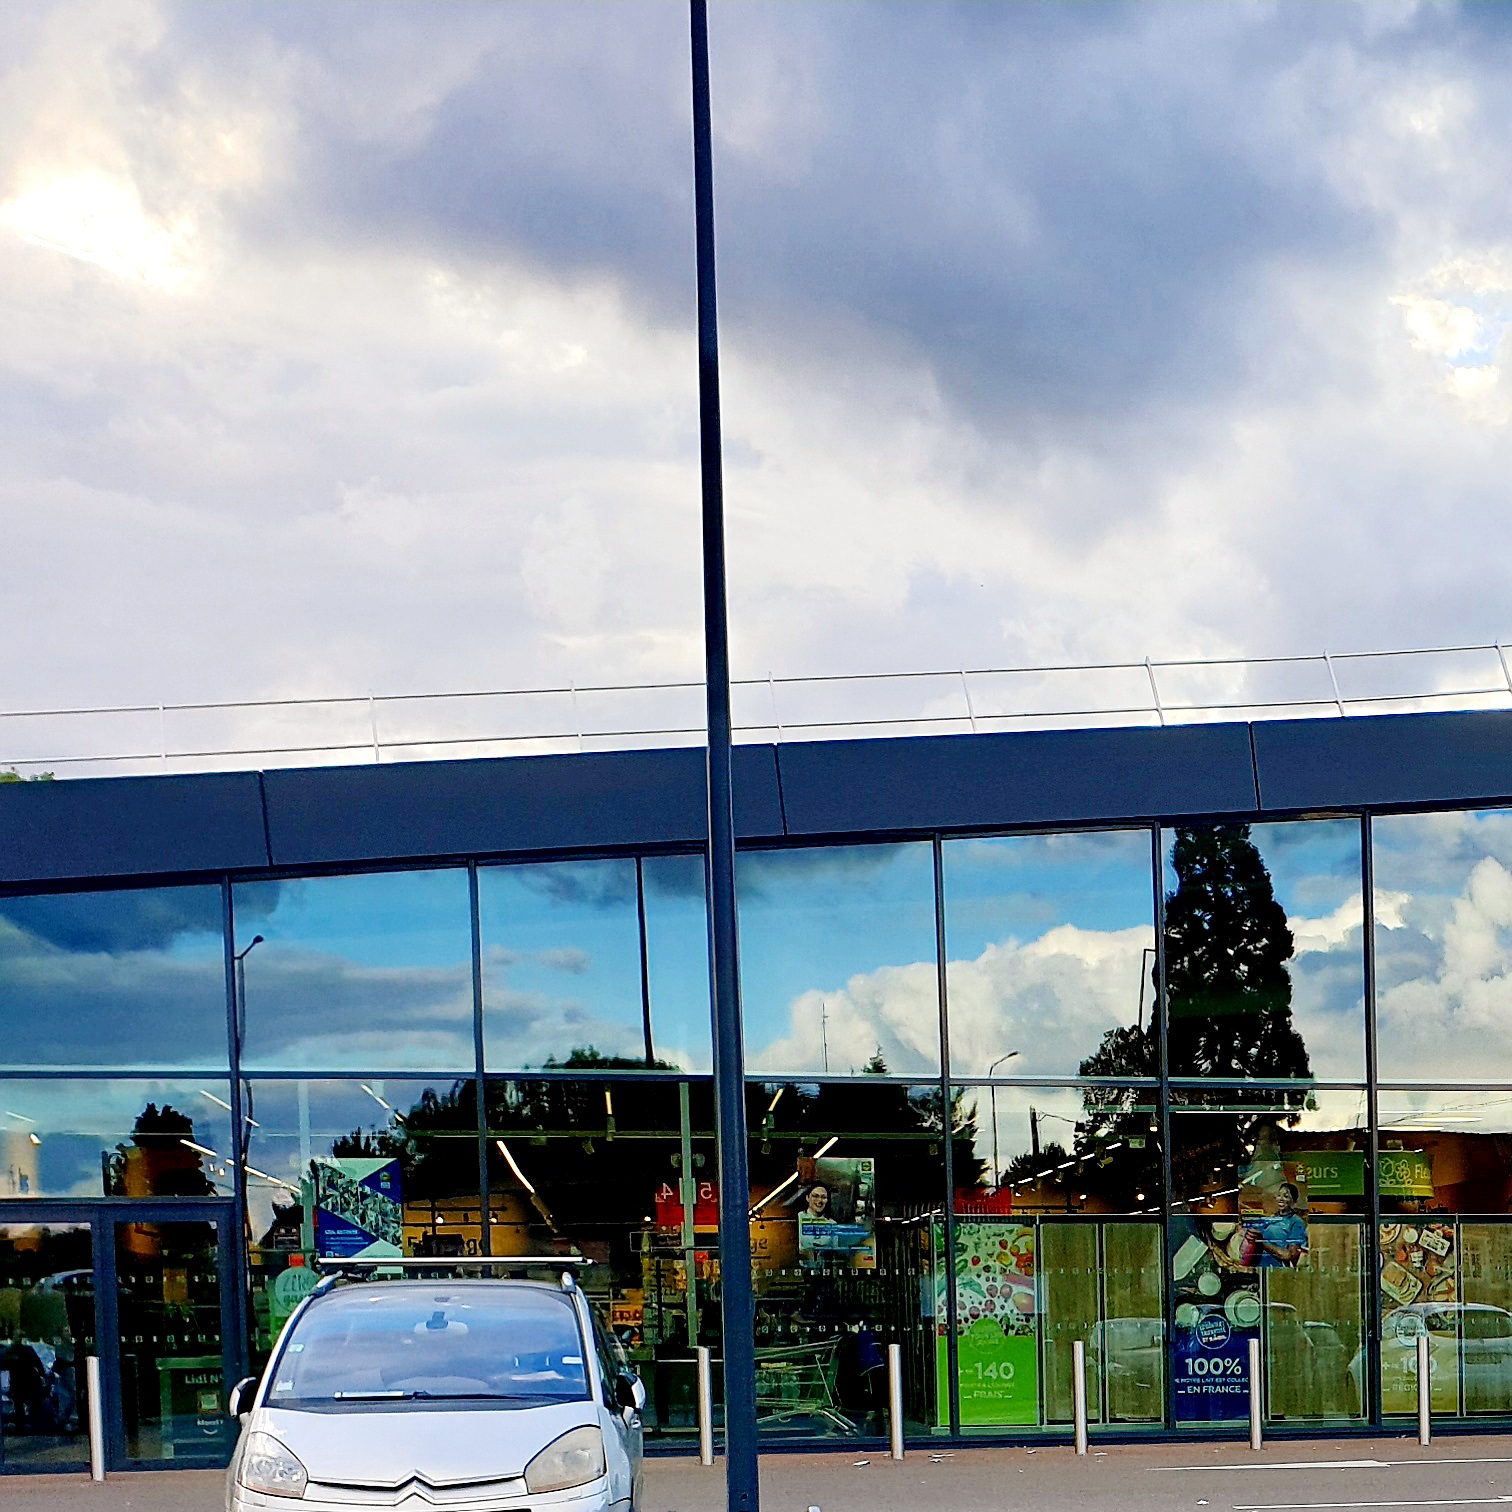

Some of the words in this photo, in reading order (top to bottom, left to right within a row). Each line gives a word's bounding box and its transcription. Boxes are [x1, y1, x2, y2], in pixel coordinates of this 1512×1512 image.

[1306, 1165, 1339, 1179] eurs
[973, 1361, 1015, 1380] 140
[1184, 1357, 1242, 1376] 100%
[1187, 1385, 1201, 1394] EN
[1202, 1385, 1242, 1394] FRANCE
